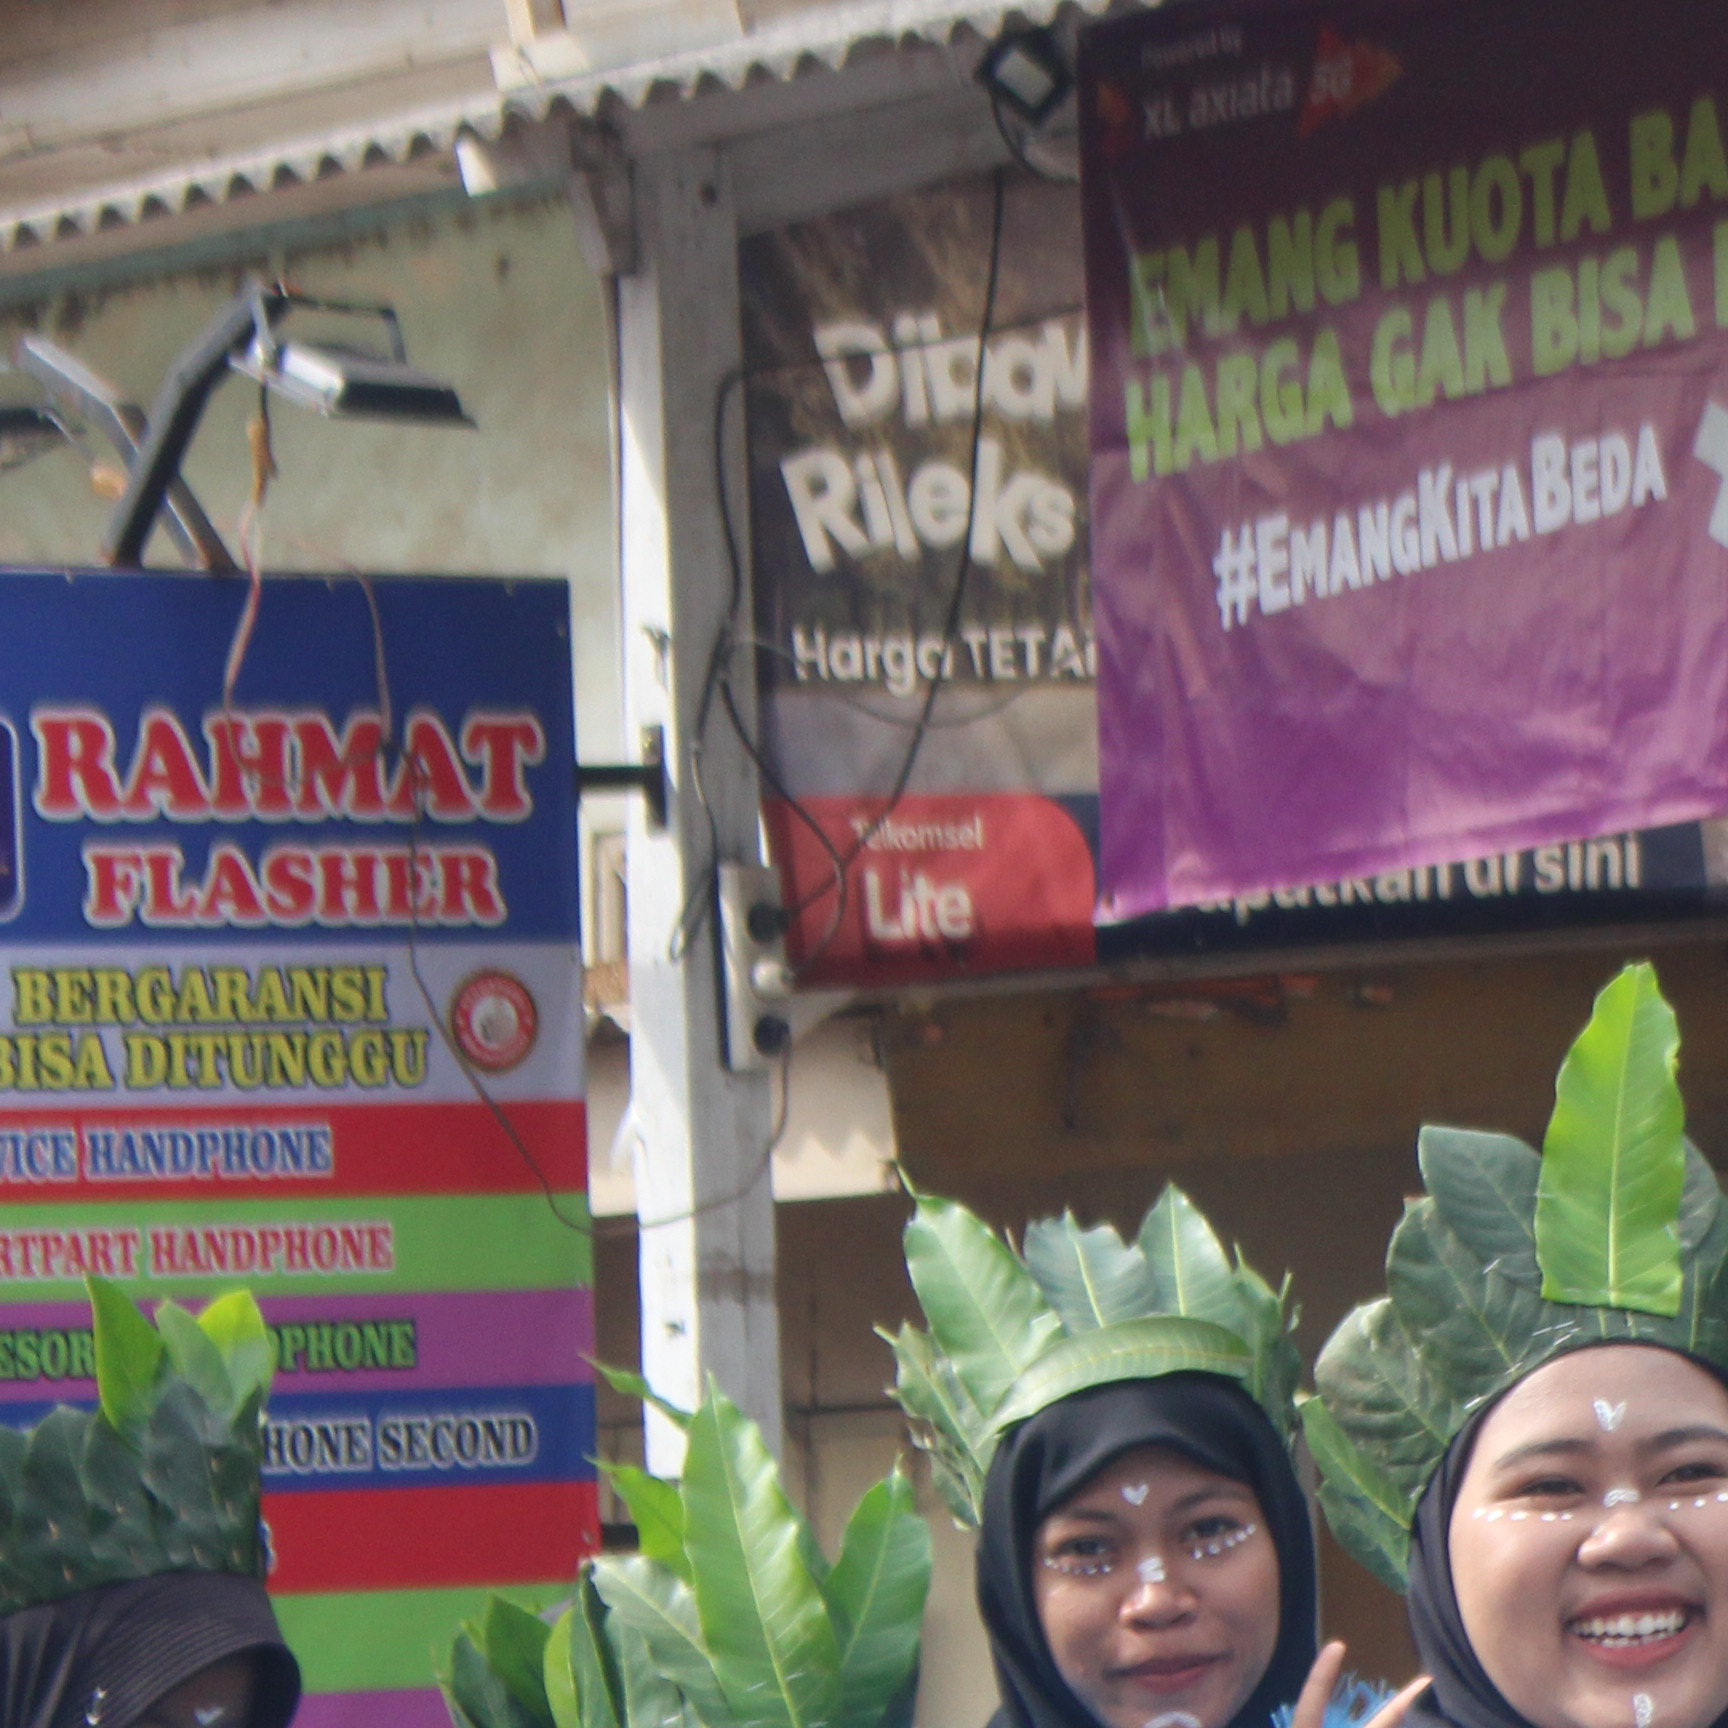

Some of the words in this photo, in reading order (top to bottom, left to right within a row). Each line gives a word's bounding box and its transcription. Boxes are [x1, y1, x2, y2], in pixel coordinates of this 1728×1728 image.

[1187, 62, 1295, 131] axiata
[1129, 196, 1361, 359] EMANG
[1377, 128, 1613, 292] KUOTA
[1124, 322, 1354, 484] HARGA
[1370, 281, 1514, 419] GAK
[1529, 232, 1697, 378] BISA
[780, 438, 1078, 576] Rileks
[791, 622, 954, 698] Harga
[29, 703, 547, 823] RAHMAT
[849, 812, 985, 851] Telkomsel
[82, 842, 508, 929] FLASHER
[863, 866, 975, 943] Lite
[11, 964, 391, 1027] BERGARANSI
[123, 1028, 431, 1091] DITUNGGU
[0, 1128, 78, 1183] ICE
[84, 1122, 335, 1181] HANDPHONE
[148, 1218, 396, 1278] HANDPHONE
[378, 1412, 538, 1472] SECOND
